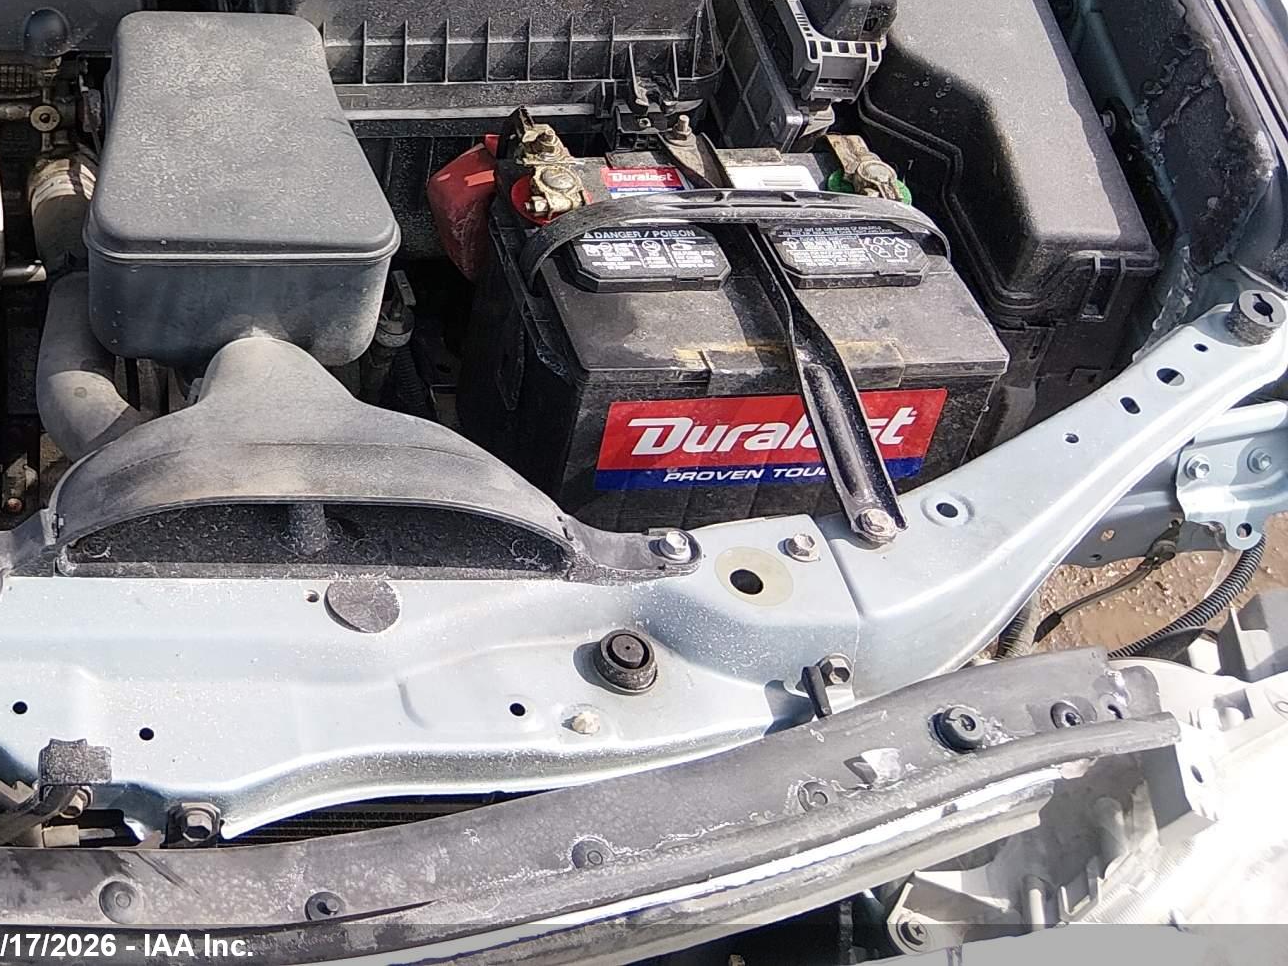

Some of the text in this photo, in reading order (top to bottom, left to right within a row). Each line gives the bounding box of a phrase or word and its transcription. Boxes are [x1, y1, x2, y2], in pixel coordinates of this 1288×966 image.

[608, 172, 673, 182] Duralast
[594, 231, 641, 239] DANGER
[653, 230, 696, 238] POISON
[627, 406, 917, 456] Duralt
[663, 468, 765, 483] PROVEN
